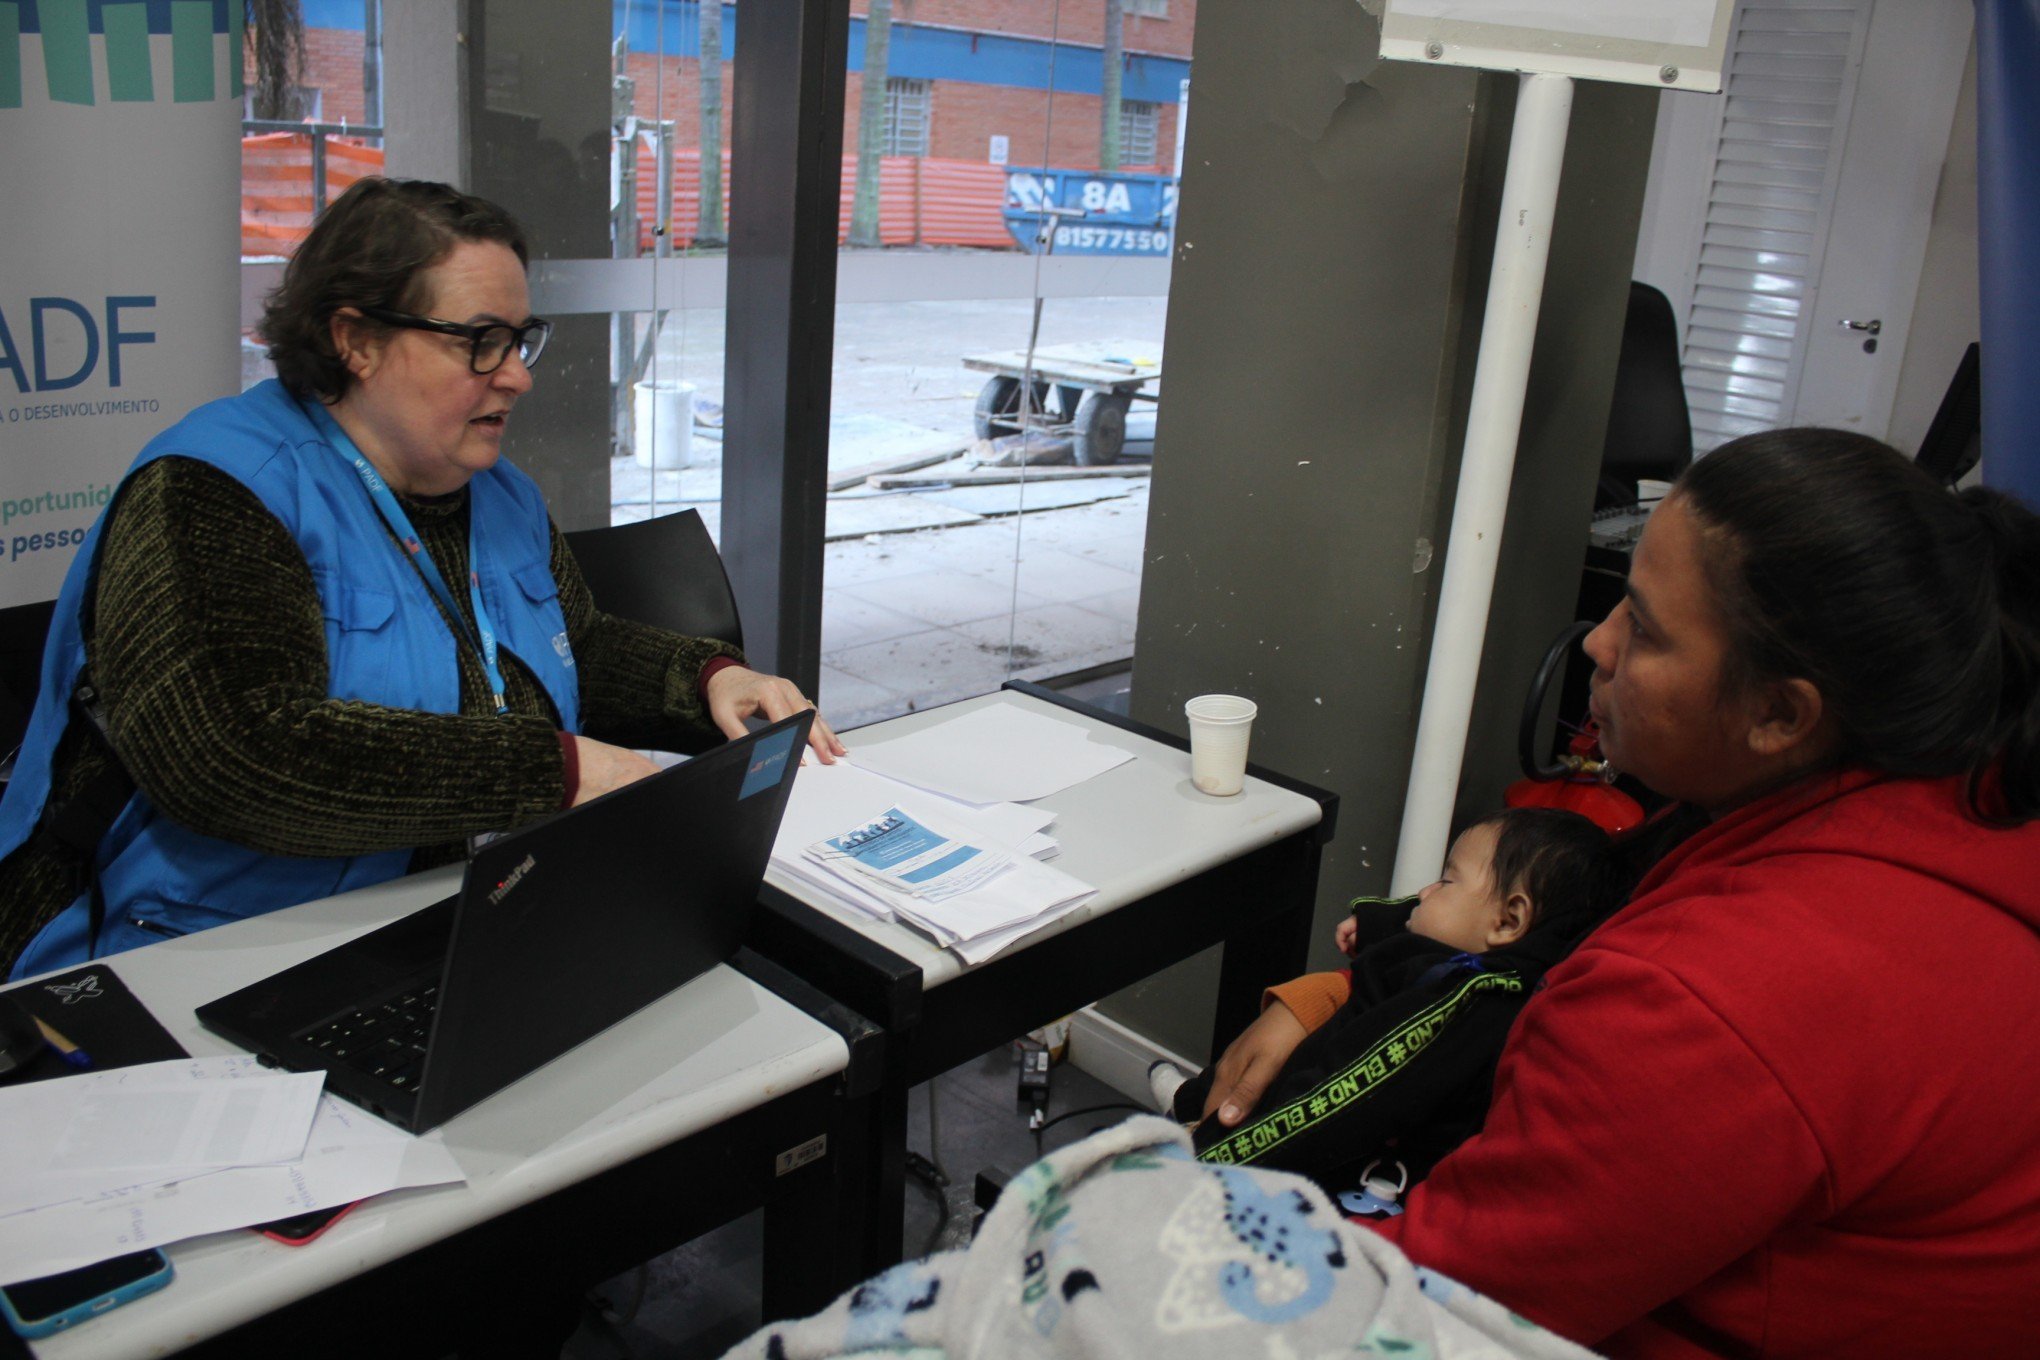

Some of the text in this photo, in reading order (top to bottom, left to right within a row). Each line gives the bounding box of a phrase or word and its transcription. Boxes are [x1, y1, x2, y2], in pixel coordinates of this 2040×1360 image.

[1056, 226, 1168, 251] 81577550
[9, 408, 19, 422] O
[25, 400, 160, 421] DESENVOLVIMENTO
[12, 528, 91, 562] pesso
[1328, 1054, 1387, 1106] BLND
[1251, 1105, 1306, 1149] BLND
